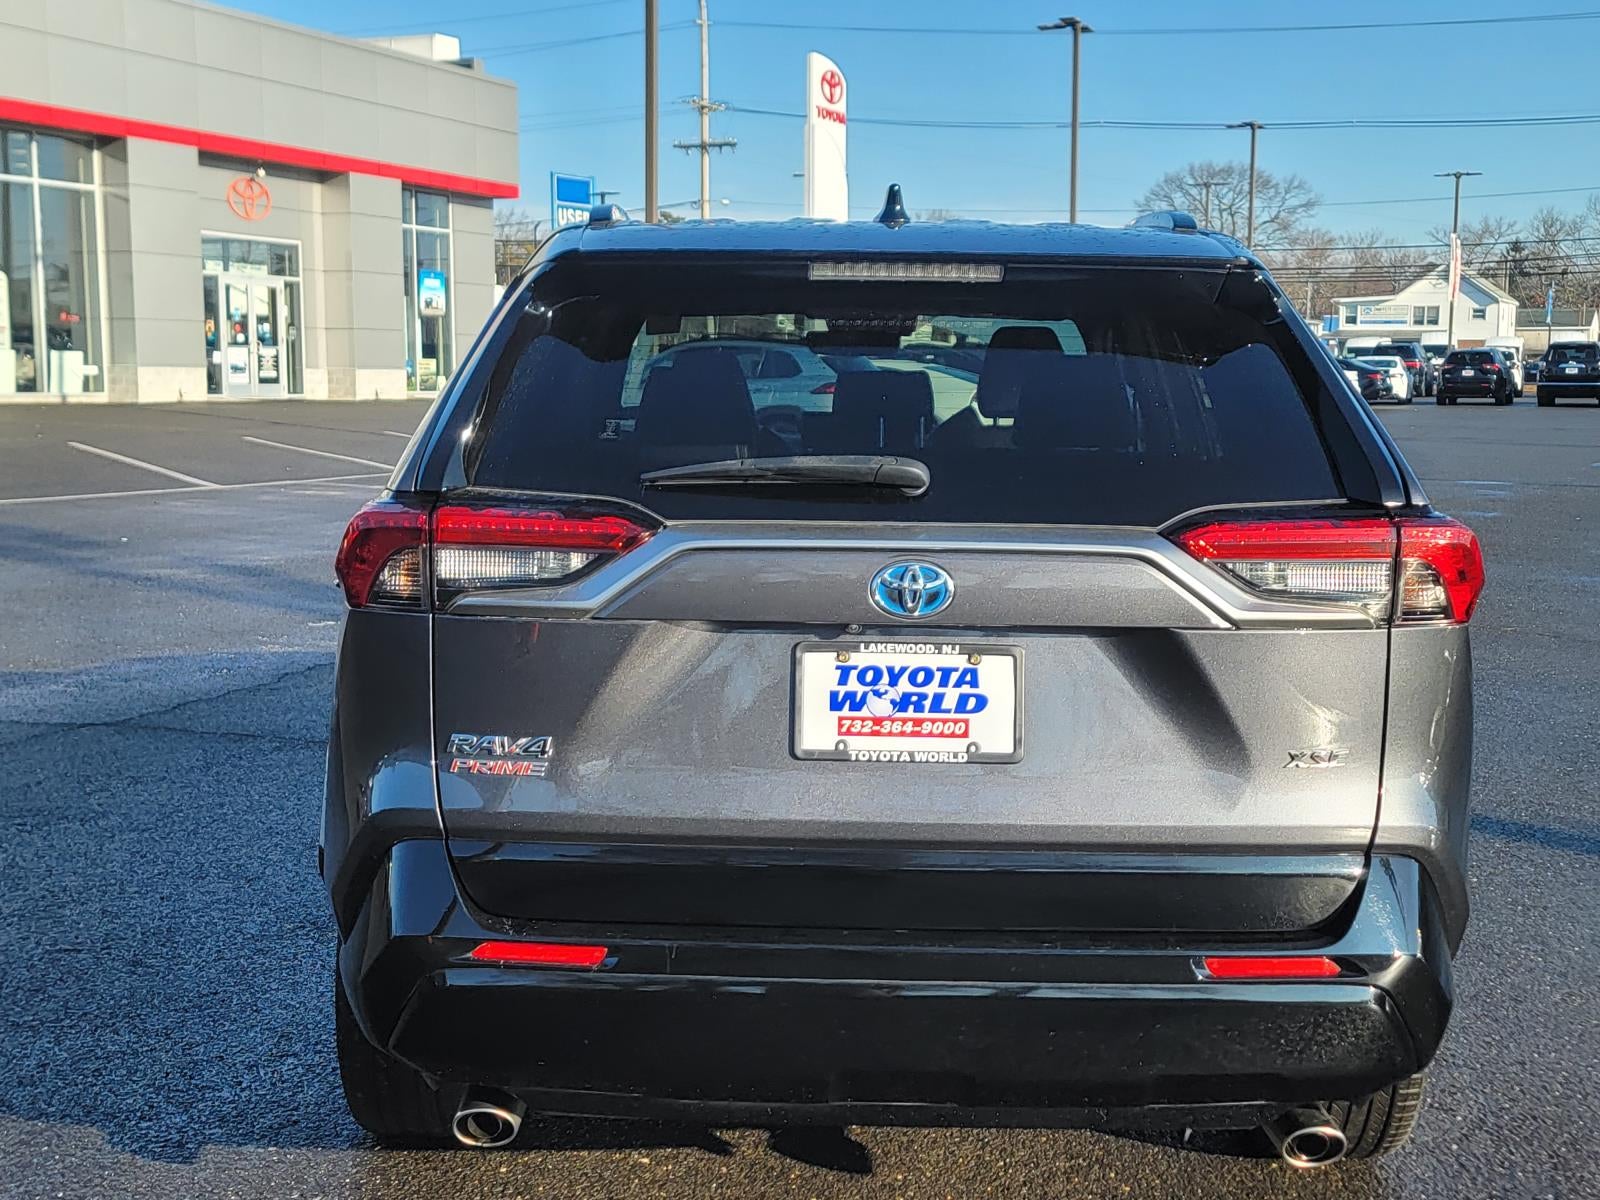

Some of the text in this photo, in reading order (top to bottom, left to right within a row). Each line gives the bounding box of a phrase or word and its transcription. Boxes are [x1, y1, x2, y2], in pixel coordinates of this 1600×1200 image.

[816, 105, 846, 126] TOYOTA
[860, 643, 960, 655] LAKEWOOD, NJ
[835, 665, 980, 688] TOYOTA
[840, 719, 966, 735] 732-364-9000
[447, 733, 553, 758] RAV4
[850, 750, 968, 763] TOYOTA WORLD
[450, 758, 548, 776] PRIME
